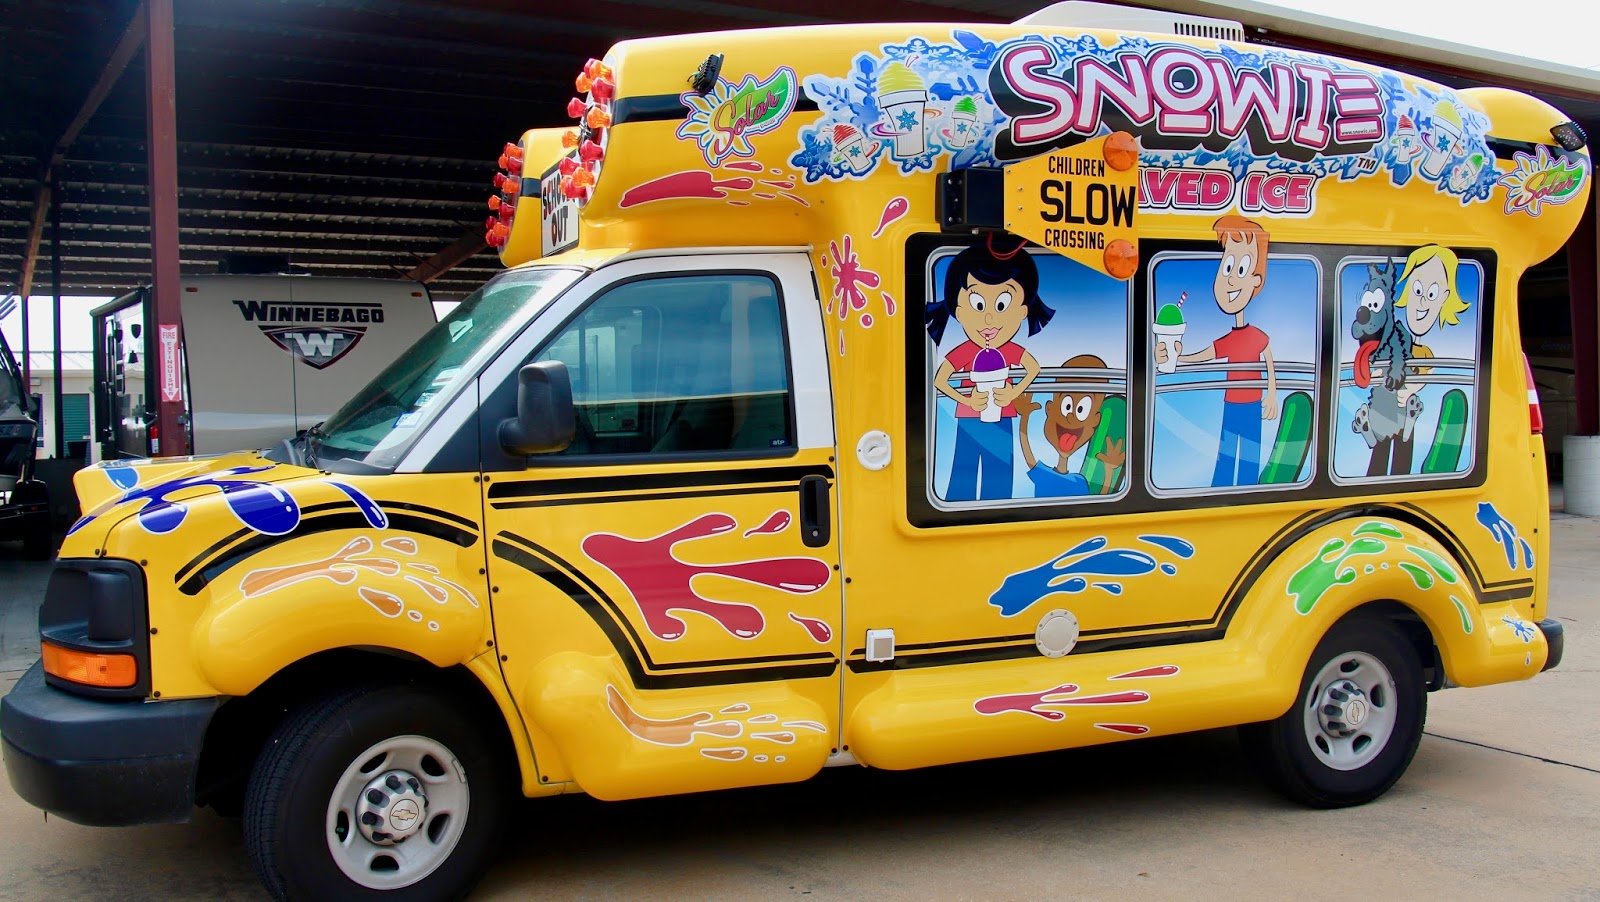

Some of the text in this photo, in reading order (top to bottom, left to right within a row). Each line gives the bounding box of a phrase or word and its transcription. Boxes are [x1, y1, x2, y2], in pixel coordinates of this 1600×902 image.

[1001, 46, 1383, 147] SNOWIE
[714, 90, 780, 156] Solar
[1048, 155, 1105, 178] CHILDREN
[1357, 157, 1376, 170] TM
[542, 173, 576, 220] SCHO
[1040, 179, 1136, 228] SLOW
[1138, 170, 1314, 209] VED ICE
[1514, 171, 1576, 207] Solar
[551, 205, 569, 247] OUT
[1044, 228, 1105, 250] CROSSING
[232, 300, 384, 323] WINNEBAGO
[162, 331, 176, 339] FIRE
[284, 333, 344, 357] W
[166, 341, 174, 396] EXTINGUISHER
